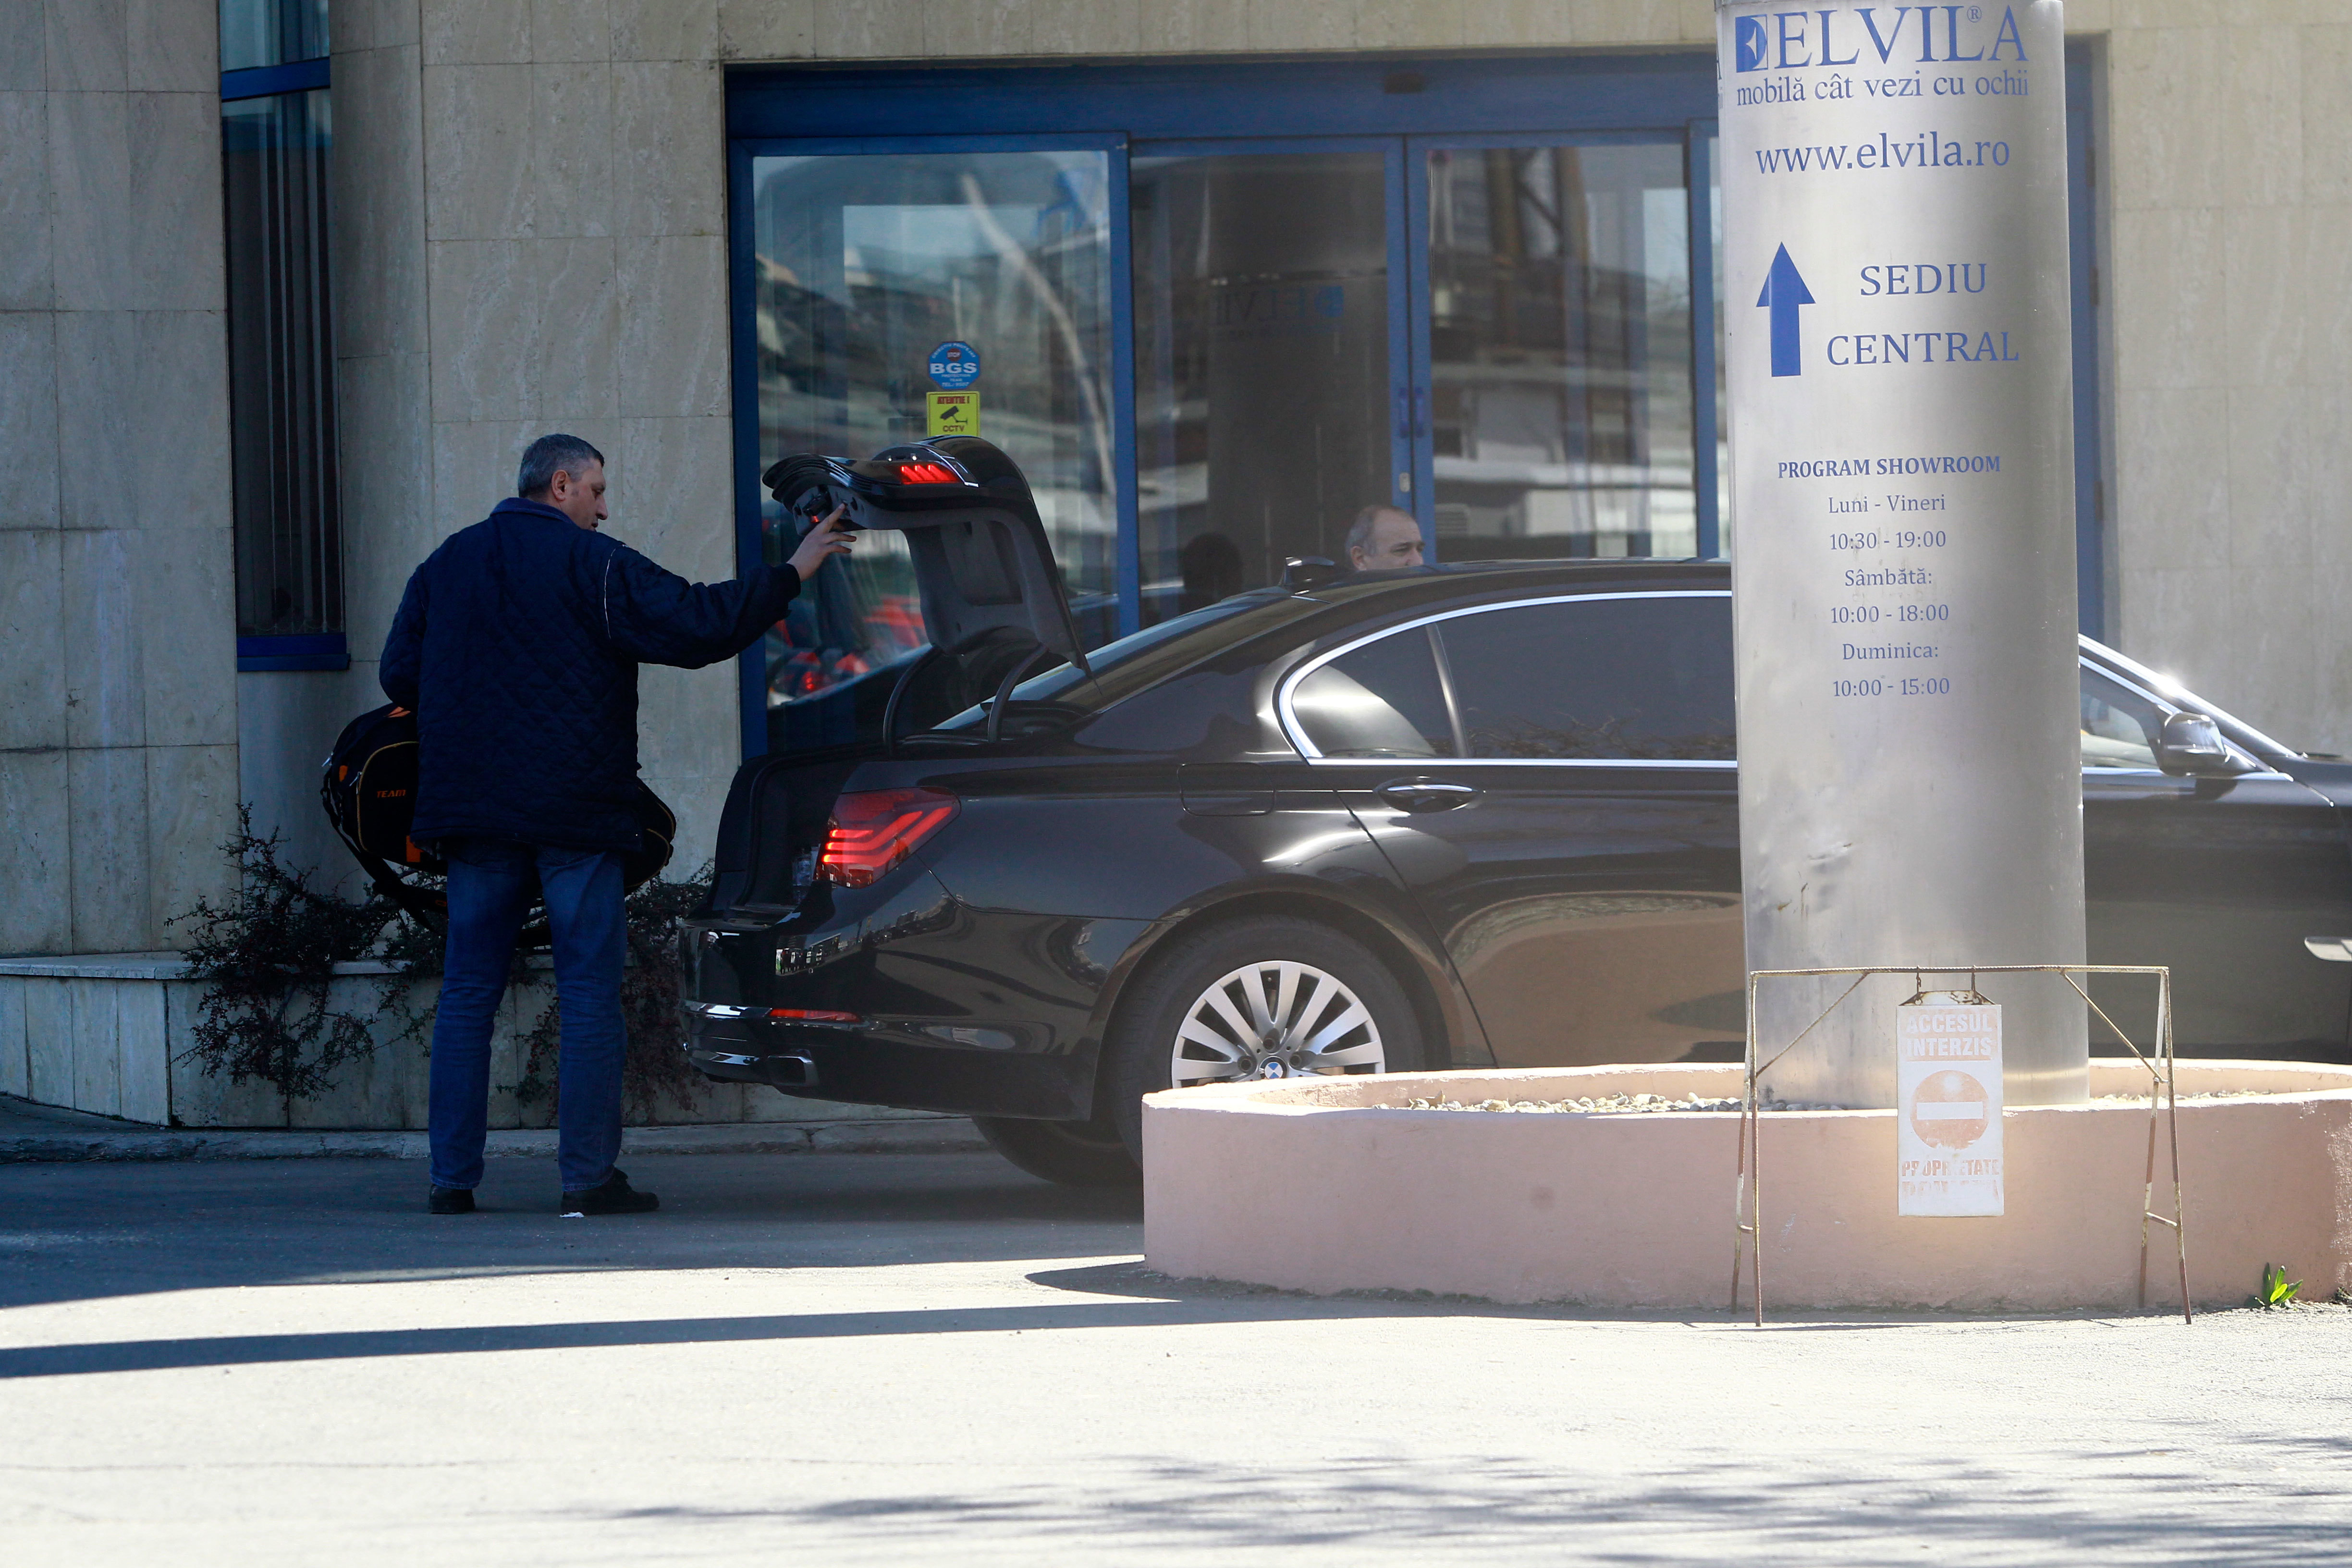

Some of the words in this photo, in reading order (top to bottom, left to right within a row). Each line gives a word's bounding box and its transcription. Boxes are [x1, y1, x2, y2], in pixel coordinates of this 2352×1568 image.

[1737, 76, 1806, 106] mobilă
[1814, 73, 1853, 99] cât
[1863, 70, 1923, 97] vezi
[1933, 76, 1965, 96] cu
[1975, 69, 2029, 96] ochii
[1755, 131, 2010, 174] www.elvila.ro
[1860, 263, 1987, 296] SEDIU
[1827, 331, 2019, 366] CENTRAL
[930, 362, 978, 374] BGS
[1778, 459, 1870, 478] PROGRAM
[1876, 455, 2001, 476] SHOWROOM
[1828, 496, 1868, 514] Luni
[1886, 494, 1946, 512] Vineri
[1829, 532, 1878, 551] 10:30
[1896, 530, 1947, 548] 19:00
[1844, 567, 1933, 587] Sâmbătă:
[1831, 606, 1879, 624] 10:00
[1898, 604, 1949, 622] 18:00
[1842, 642, 1939, 660] Duminica:
[1833, 679, 1882, 697] 10:00
[1900, 677, 1950, 695] 15:00
[377, 789, 406, 797] TEAM
[1905, 1013, 1993, 1033] ACCESUL
[1906, 1037, 1992, 1057] INTERZIS
